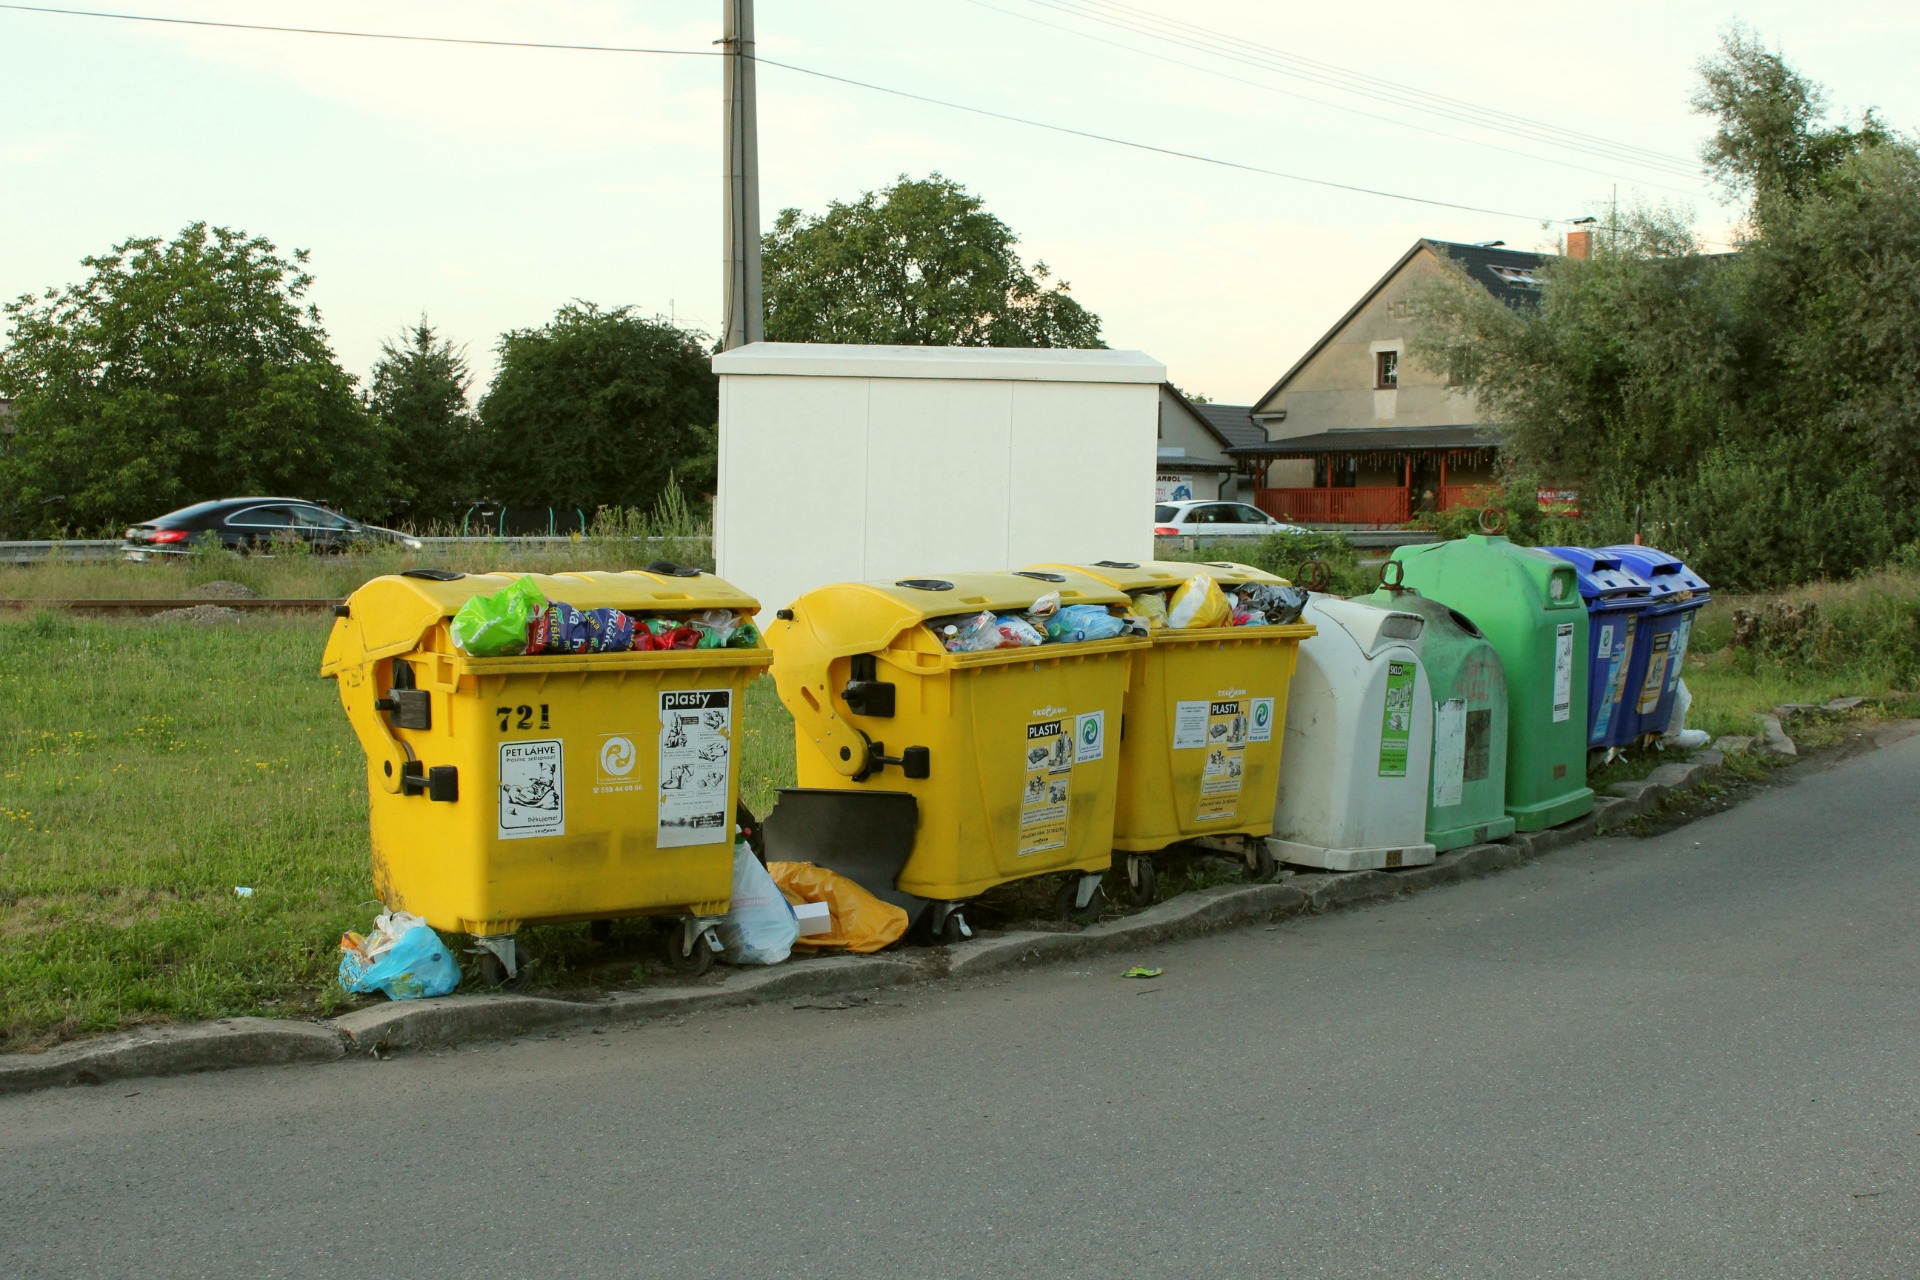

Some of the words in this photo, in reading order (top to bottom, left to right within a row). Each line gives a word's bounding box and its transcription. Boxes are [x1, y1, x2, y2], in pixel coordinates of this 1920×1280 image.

[665, 692, 711, 710] plasty
[1212, 703, 1238, 715] PLASTY
[496, 704, 551, 732] 721
[1029, 722, 1060, 738] PLASTY
[506, 748, 522, 757] PET
[525, 745, 556, 756] LÁHVE
